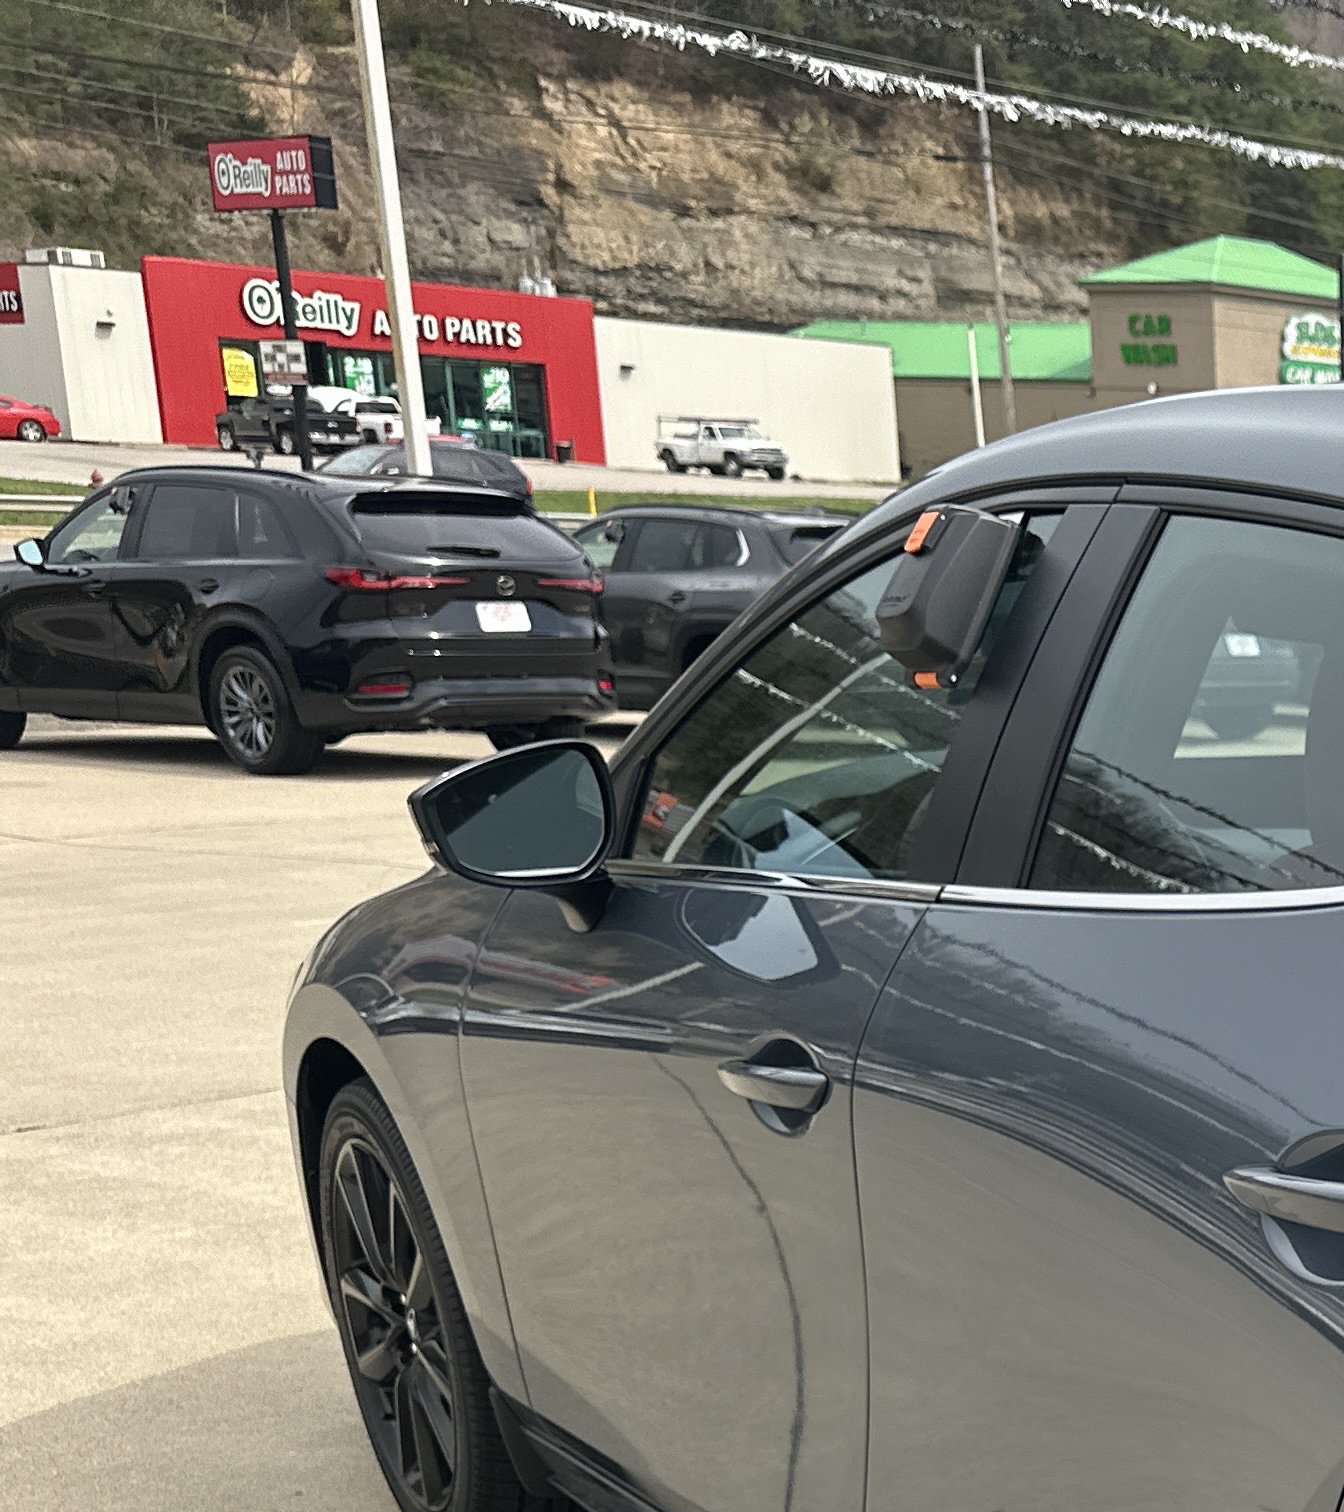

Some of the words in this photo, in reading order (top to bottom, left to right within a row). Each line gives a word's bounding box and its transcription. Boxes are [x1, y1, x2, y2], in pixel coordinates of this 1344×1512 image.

[216, 154, 271, 196] O'Reilly
[276, 150, 306, 171] AUTO
[275, 173, 311, 195] PARTS
[244, 279, 359, 335] O'eilly
[445, 316, 522, 348] PARTS
